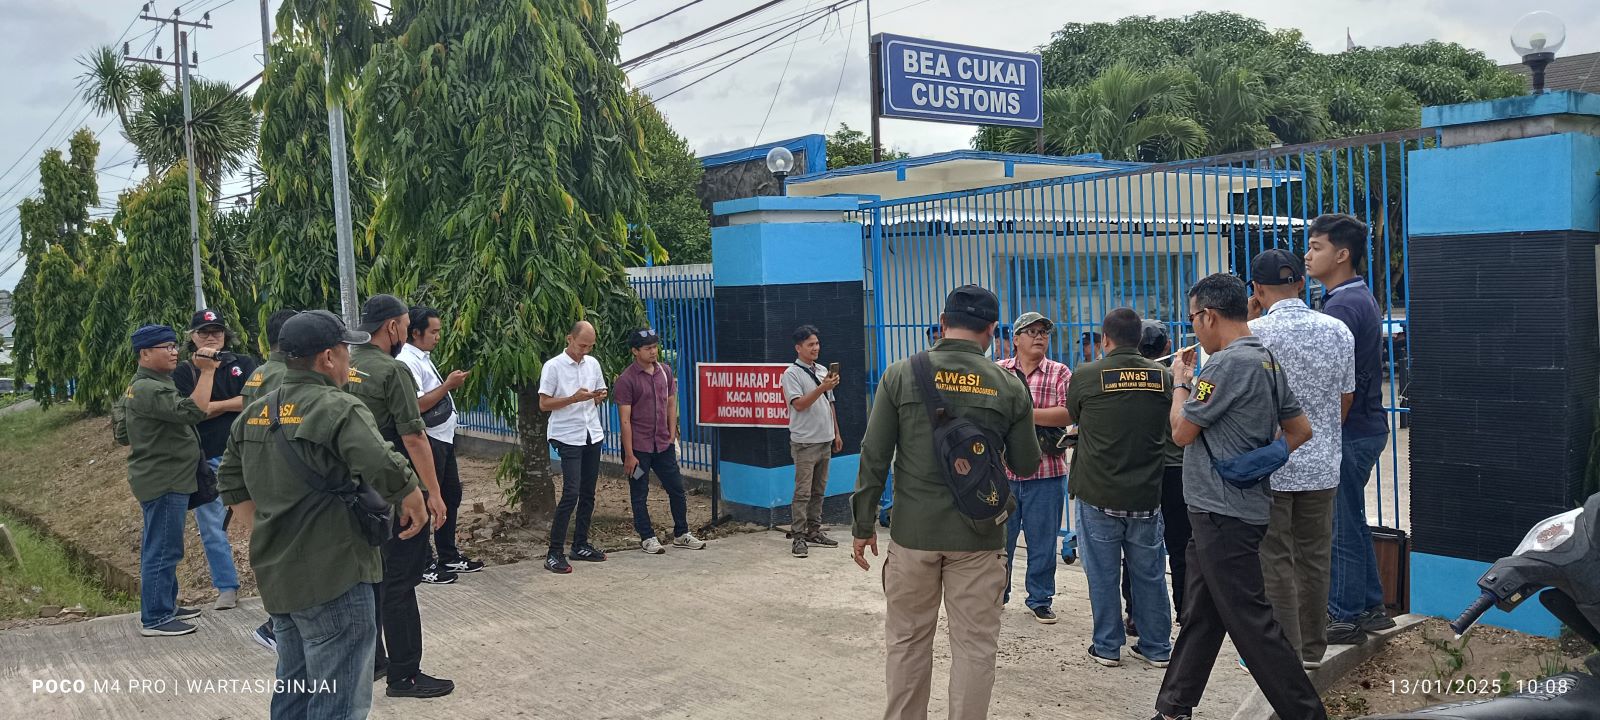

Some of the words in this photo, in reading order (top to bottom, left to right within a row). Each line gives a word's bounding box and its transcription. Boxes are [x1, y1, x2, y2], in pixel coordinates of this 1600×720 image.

[903, 49, 952, 78] BEA
[957, 56, 1026, 86] CUKAI
[911, 82, 1021, 115] CUSTOMS
[705, 372, 733, 388] TAMU
[735, 372, 770, 388] HARAP
[934, 371, 980, 386] AWaSI
[1119, 371, 1149, 381] AWaSI
[726, 391, 752, 403] KACA
[754, 392, 785, 403] MOBIL
[717, 406, 753, 418] MOHON
[755, 406, 765, 418] DI
